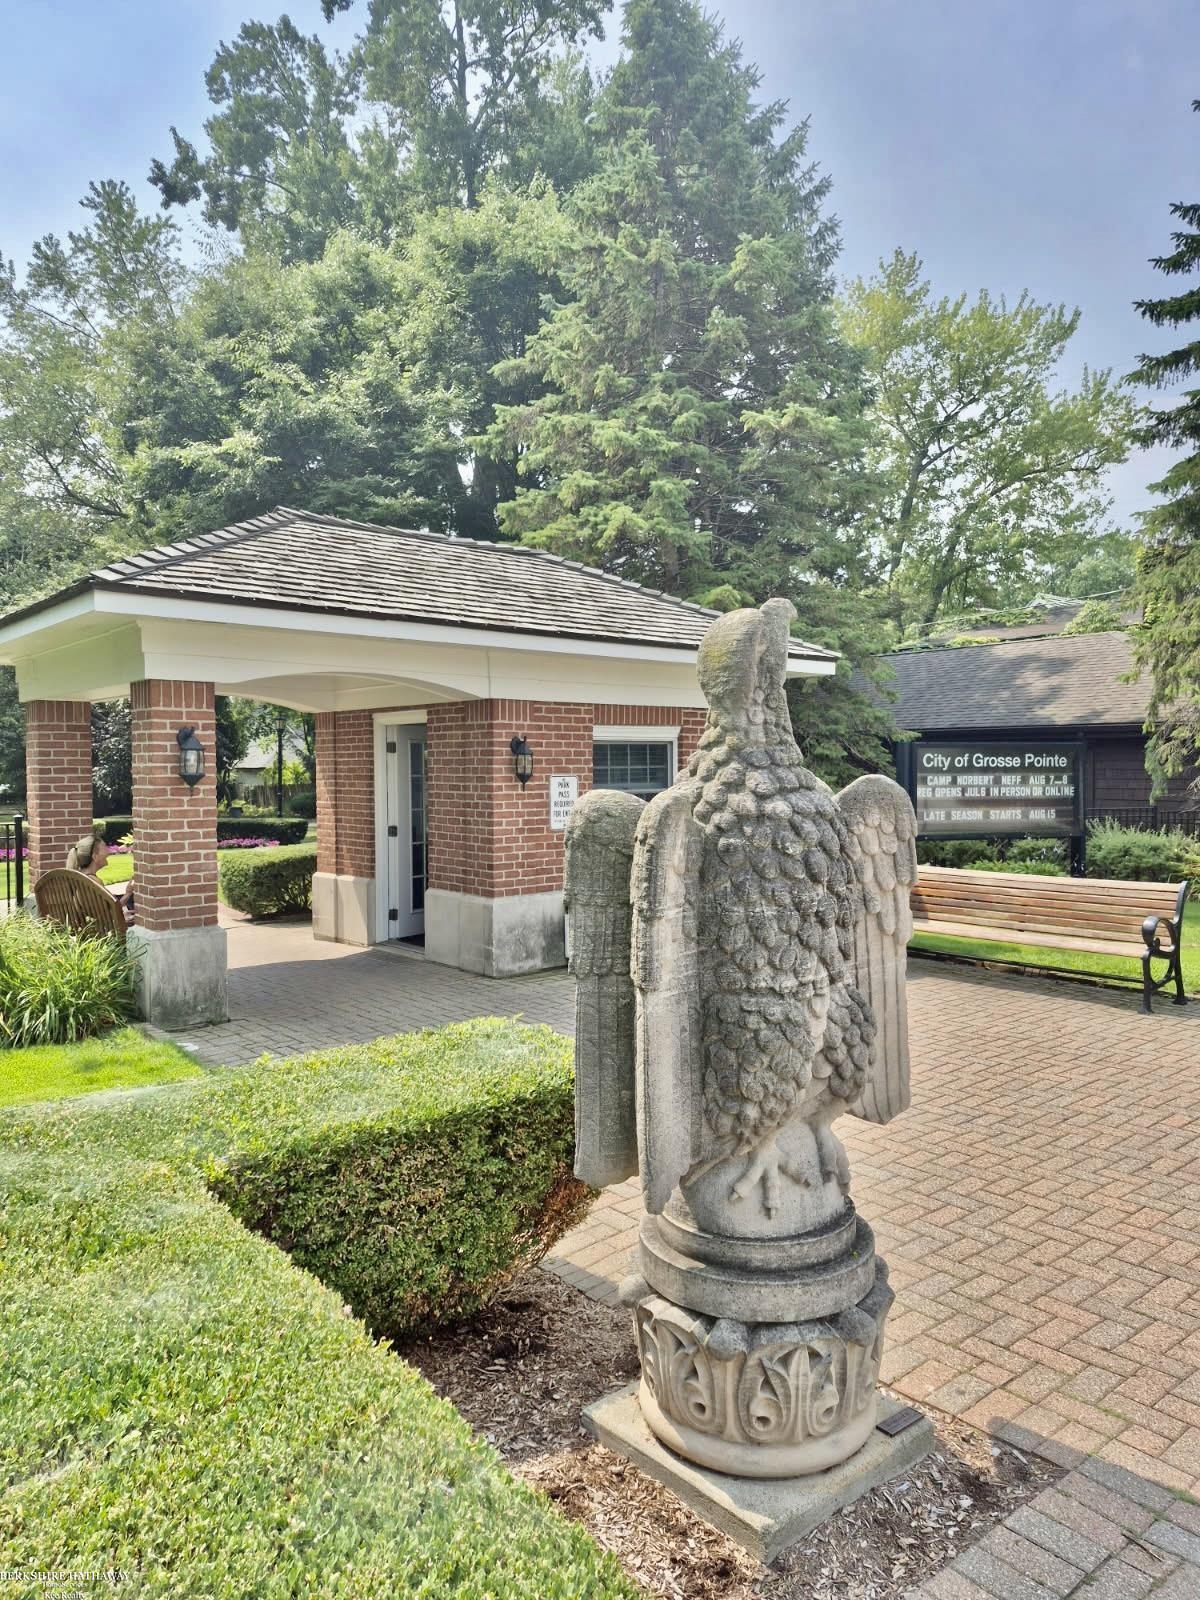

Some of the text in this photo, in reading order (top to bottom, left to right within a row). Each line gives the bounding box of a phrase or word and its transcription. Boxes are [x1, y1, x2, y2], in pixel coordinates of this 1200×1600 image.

[923, 753, 1068, 771] City of Grosse Pointe
[927, 776, 952, 786] CAMP
[957, 776, 994, 785] NORBERT
[1002, 776, 1022, 785] NEFF
[1029, 775, 1046, 785] AUG
[917, 787, 932, 798] REG
[935, 787, 962, 797] OPENS
[990, 787, 999, 797] IN
[1000, 787, 1031, 796] PERSON
[1032, 786, 1043, 796] OR
[1045, 786, 1074, 796] ONLINE
[924, 810, 946, 821] LATE
[951, 810, 983, 820] SEASON
[990, 810, 1022, 820] STARTS
[1029, 810, 1046, 820] AUG
